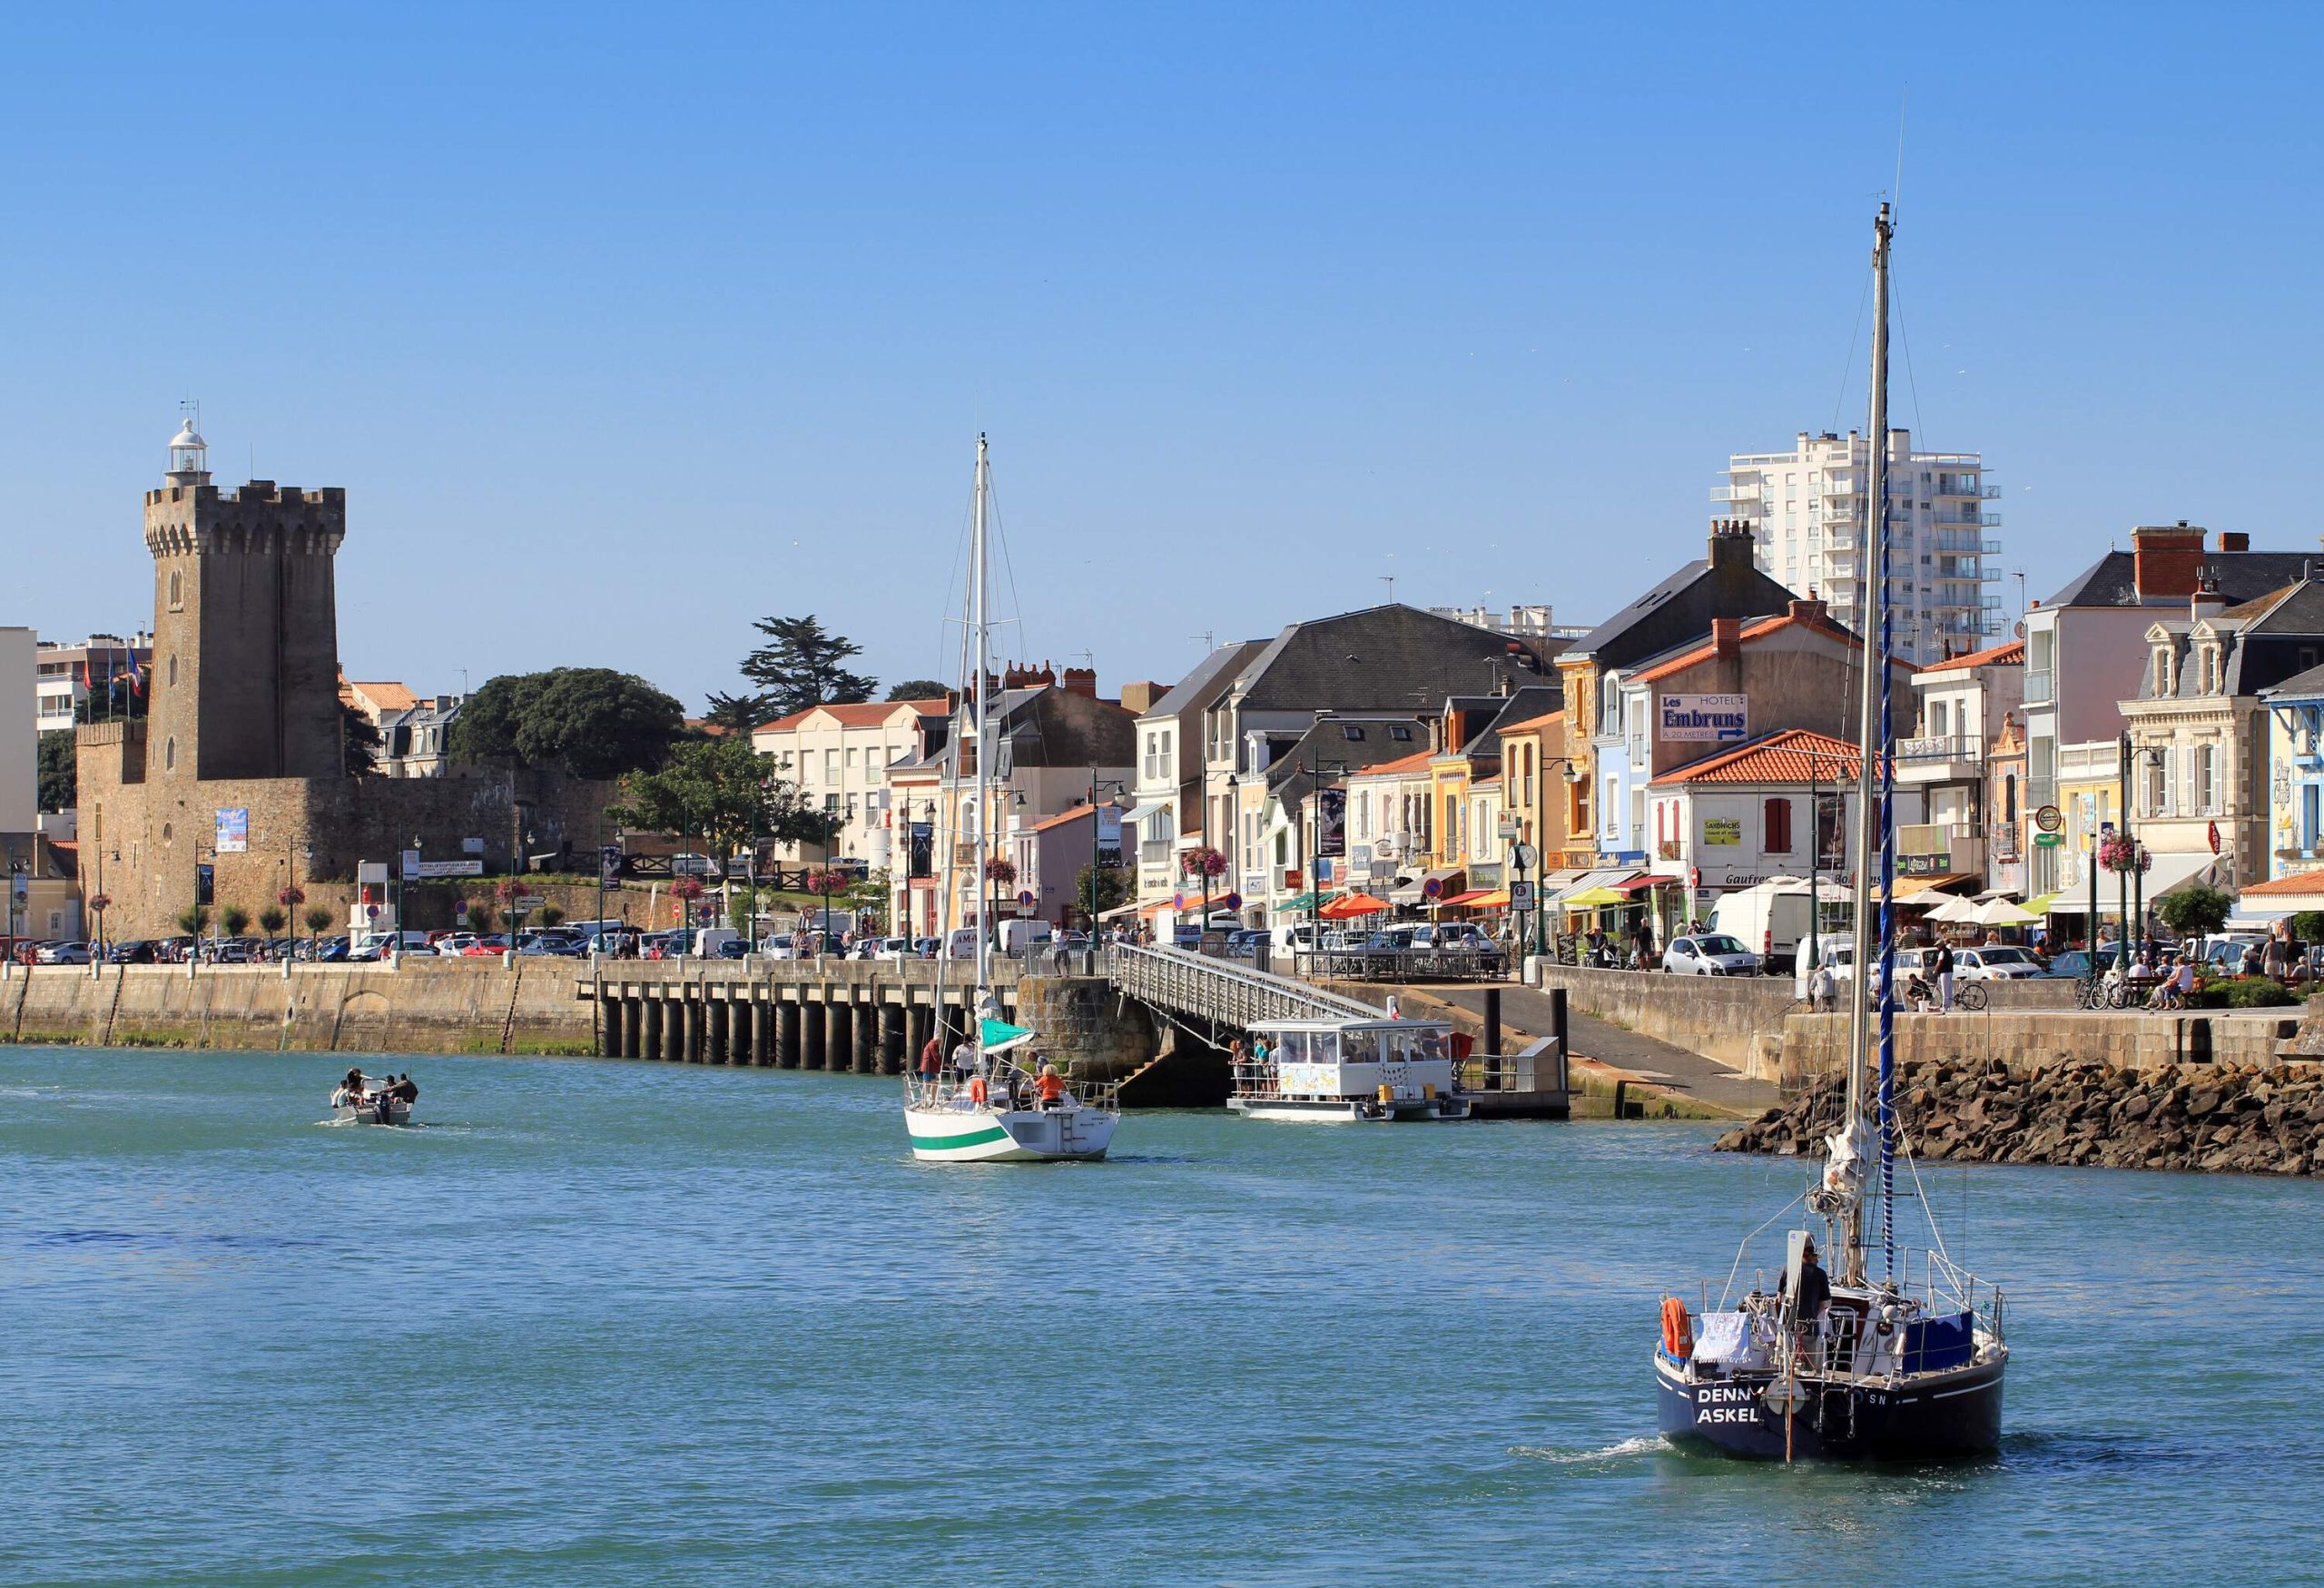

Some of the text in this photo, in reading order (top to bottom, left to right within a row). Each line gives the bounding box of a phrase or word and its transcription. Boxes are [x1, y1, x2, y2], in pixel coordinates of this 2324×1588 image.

[1663, 696, 1736, 707] Les HOTEL
[1663, 709, 1746, 728] Embruns
[2273, 756, 2290, 781] Bar
[2211, 825, 2221, 852] TABAC
[1697, 1407, 1758, 1424] ASKEL
